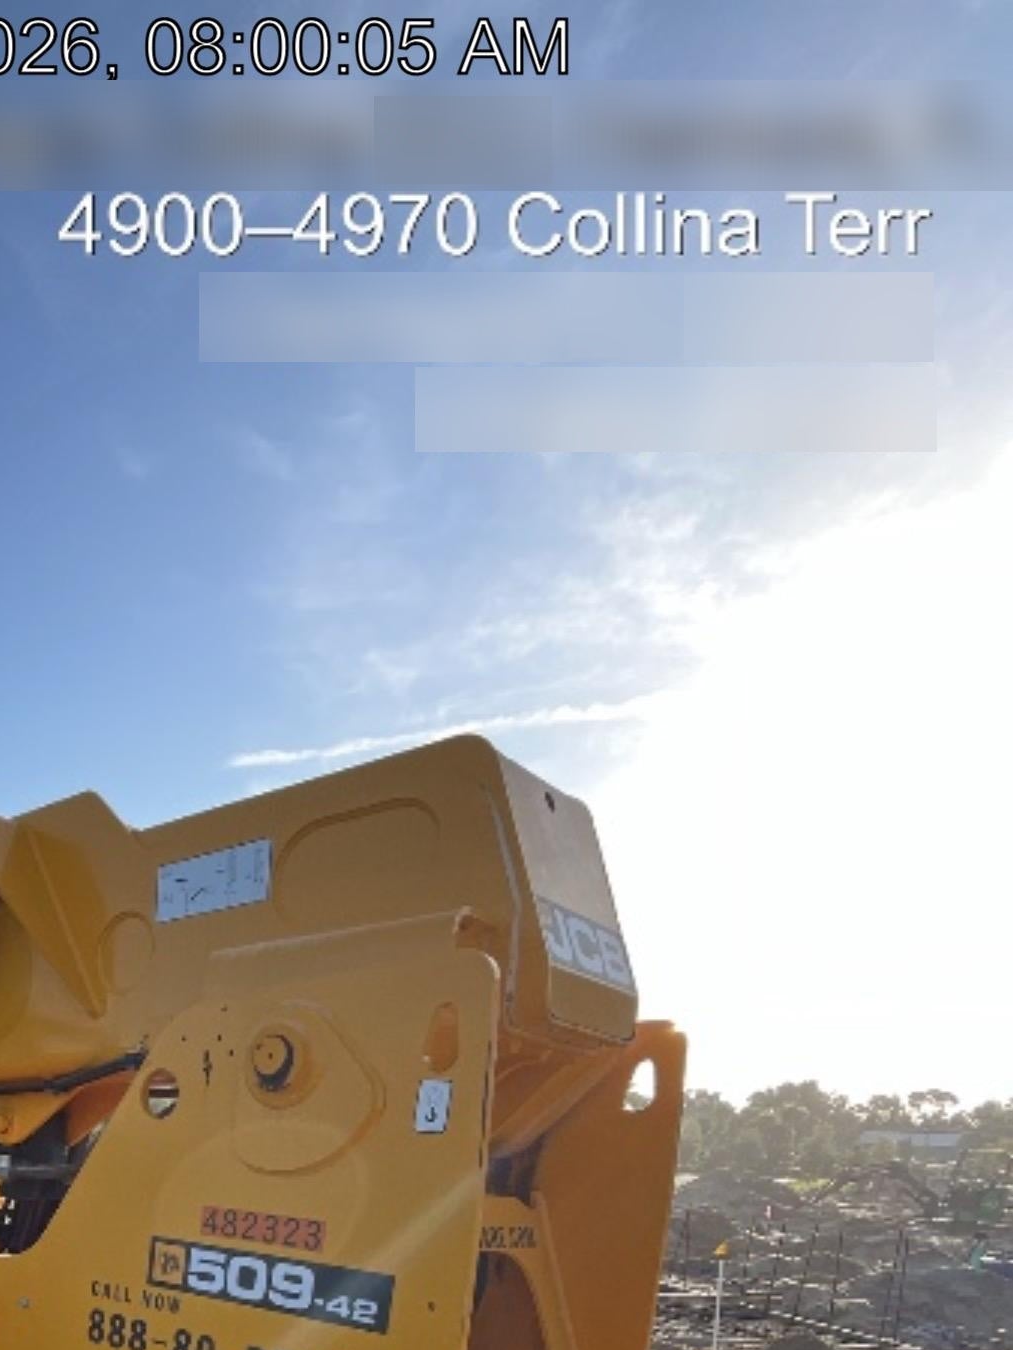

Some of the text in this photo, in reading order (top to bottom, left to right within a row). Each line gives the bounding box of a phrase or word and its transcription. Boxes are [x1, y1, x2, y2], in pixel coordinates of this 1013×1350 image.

[547, 908, 632, 986] JCB
[201, 1206, 325, 1251] 482323
[188, 1247, 379, 1325] 509-42
